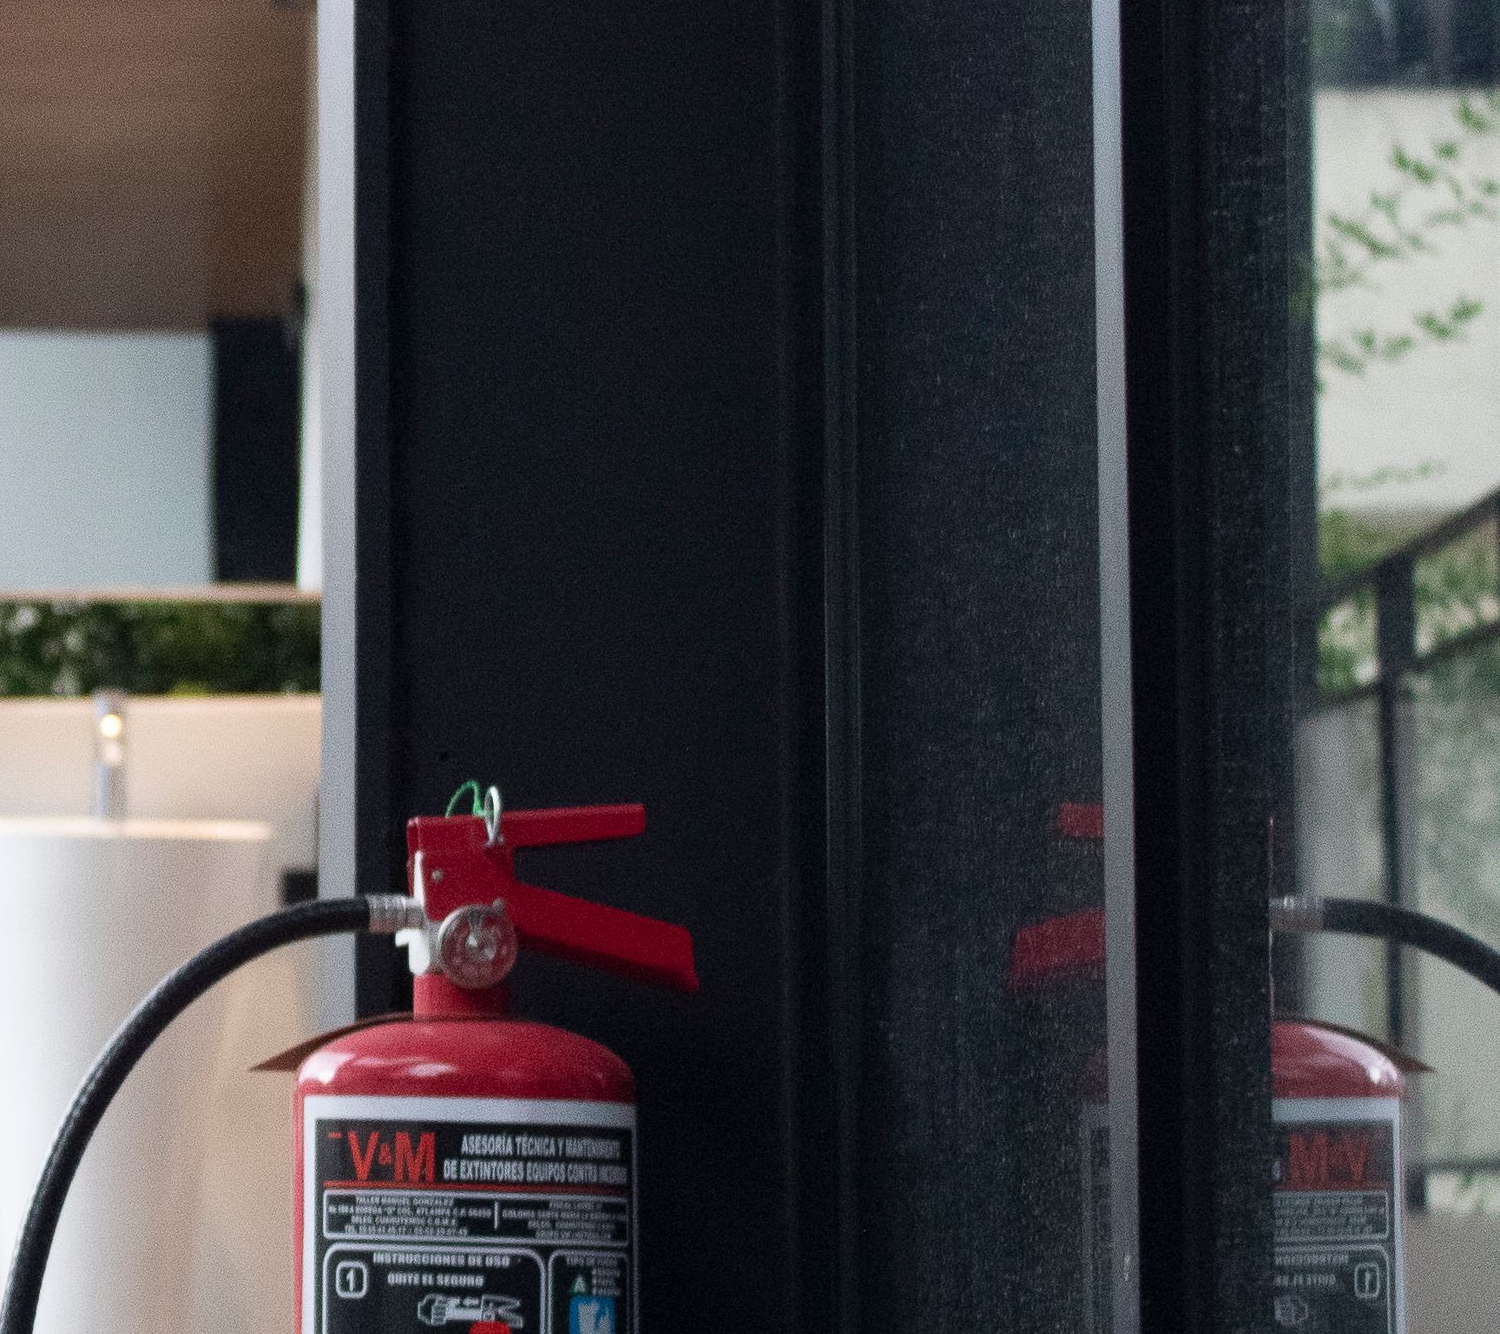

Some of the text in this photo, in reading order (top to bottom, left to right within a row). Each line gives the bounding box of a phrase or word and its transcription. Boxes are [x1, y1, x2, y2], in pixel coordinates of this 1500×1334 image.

[443, 1159, 459, 1181] DE
[460, 1159, 525, 1183] EXTINTORES
[372, 1252, 511, 1268] INSTRUCCIONES DE USO
[387, 1271, 485, 1288] QUITE EL SEGURO
